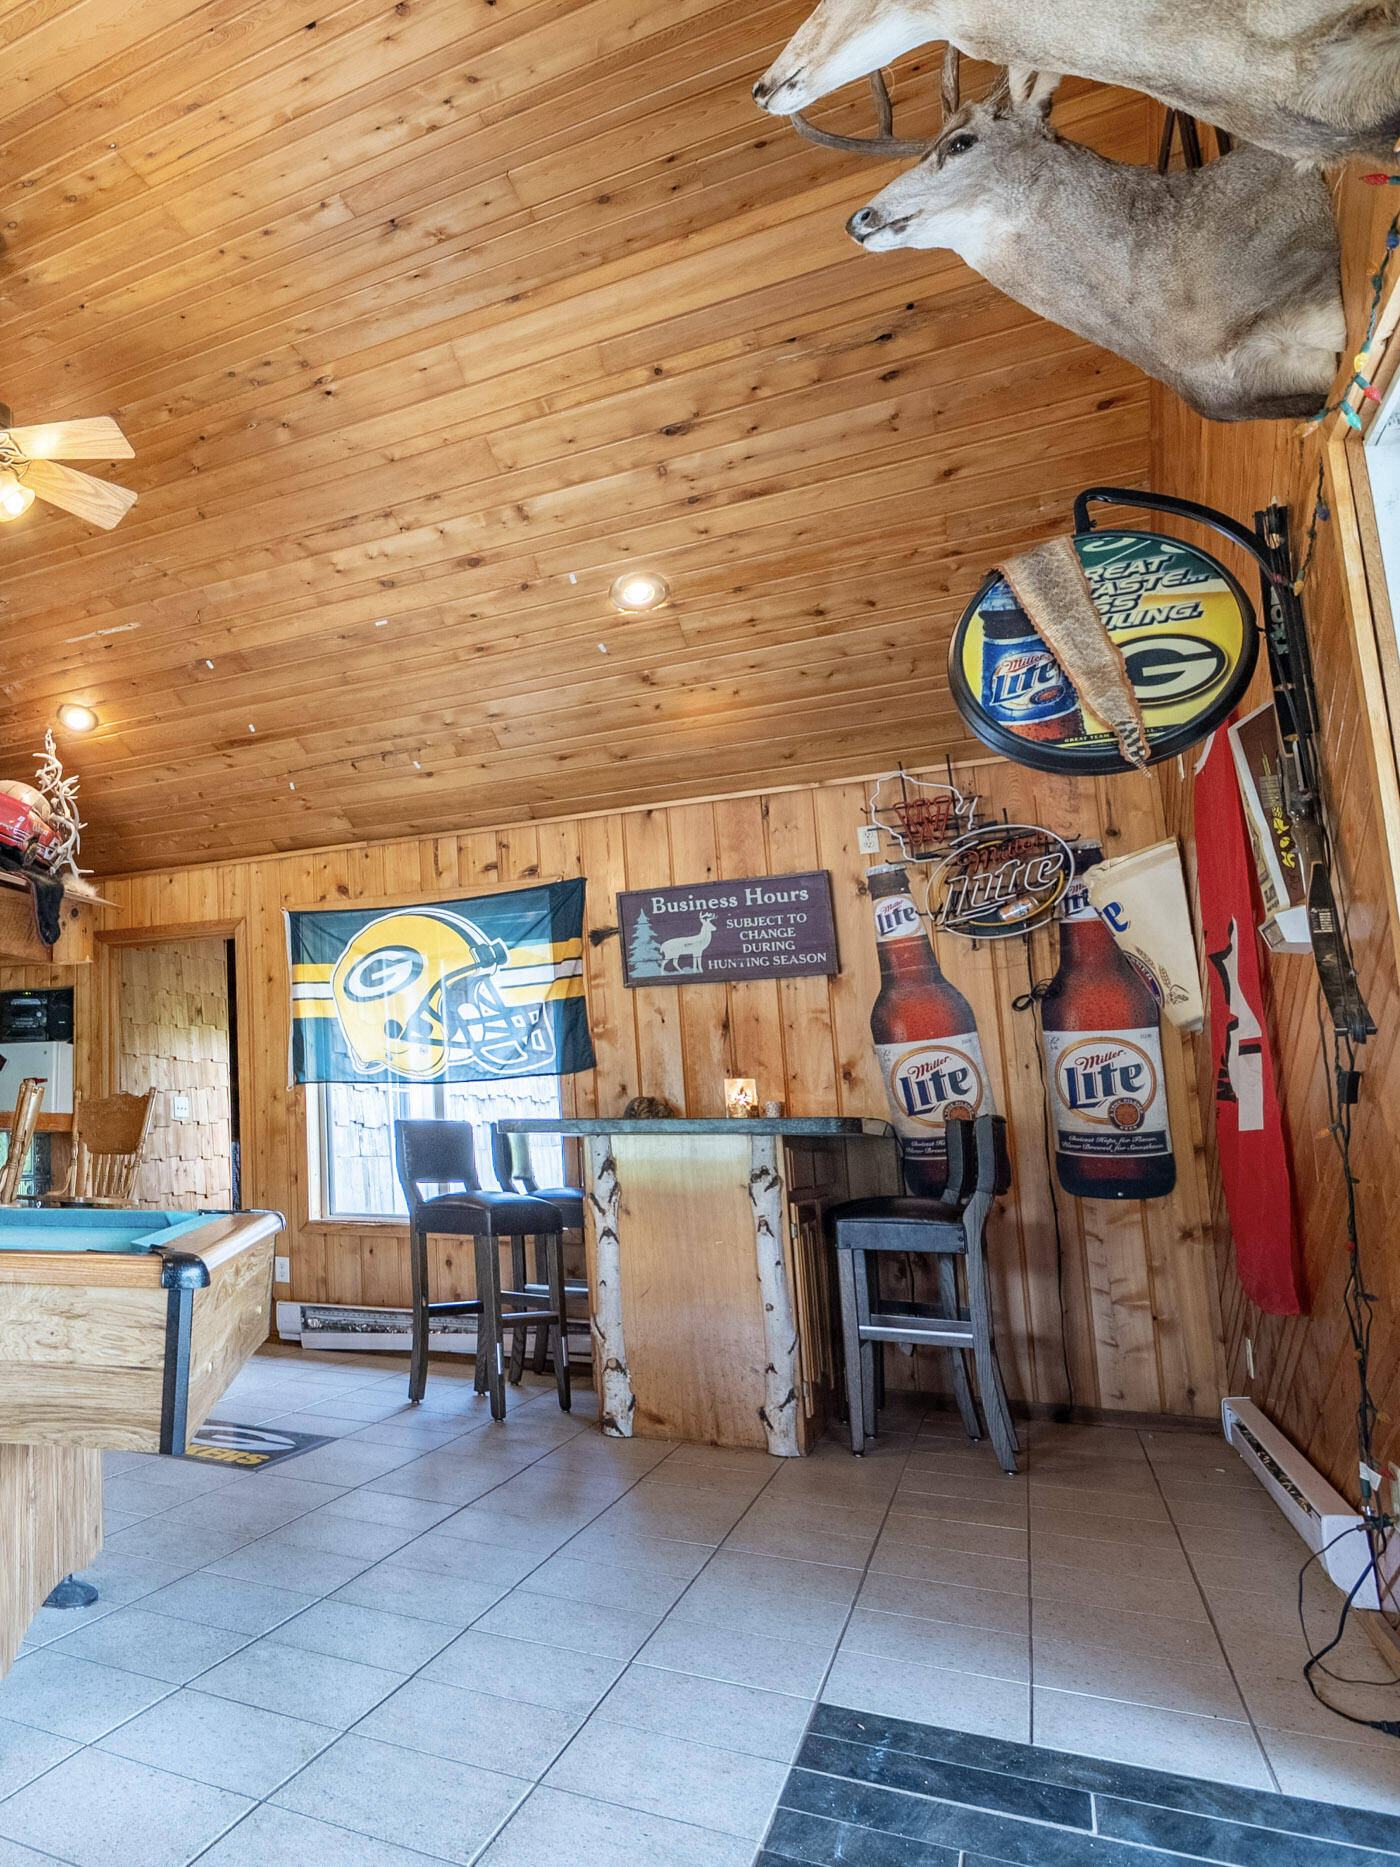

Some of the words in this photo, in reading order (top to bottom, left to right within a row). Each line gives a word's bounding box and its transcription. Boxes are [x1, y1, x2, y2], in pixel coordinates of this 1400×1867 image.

[1002, 654, 1050, 672] Miller
[992, 658, 1057, 704] Lite
[956, 835, 1045, 874] Miller
[651, 894, 738, 914] Business
[744, 886, 809, 906] Hours
[938, 852, 1064, 924] Lite
[726, 915, 784, 929] SUBJECT
[786, 913, 808, 924] TO
[739, 927, 797, 941] CHANGE
[876, 906, 917, 936] Lite
[742, 940, 796, 954] DURING
[708, 956, 770, 970] HUNTING
[772, 952, 828, 966] SEASON
[907, 1055, 951, 1080] Miller
[1074, 1049, 1125, 1072] Miller
[899, 1067, 973, 1117] Lite
[1064, 1061, 1146, 1110] Lite
